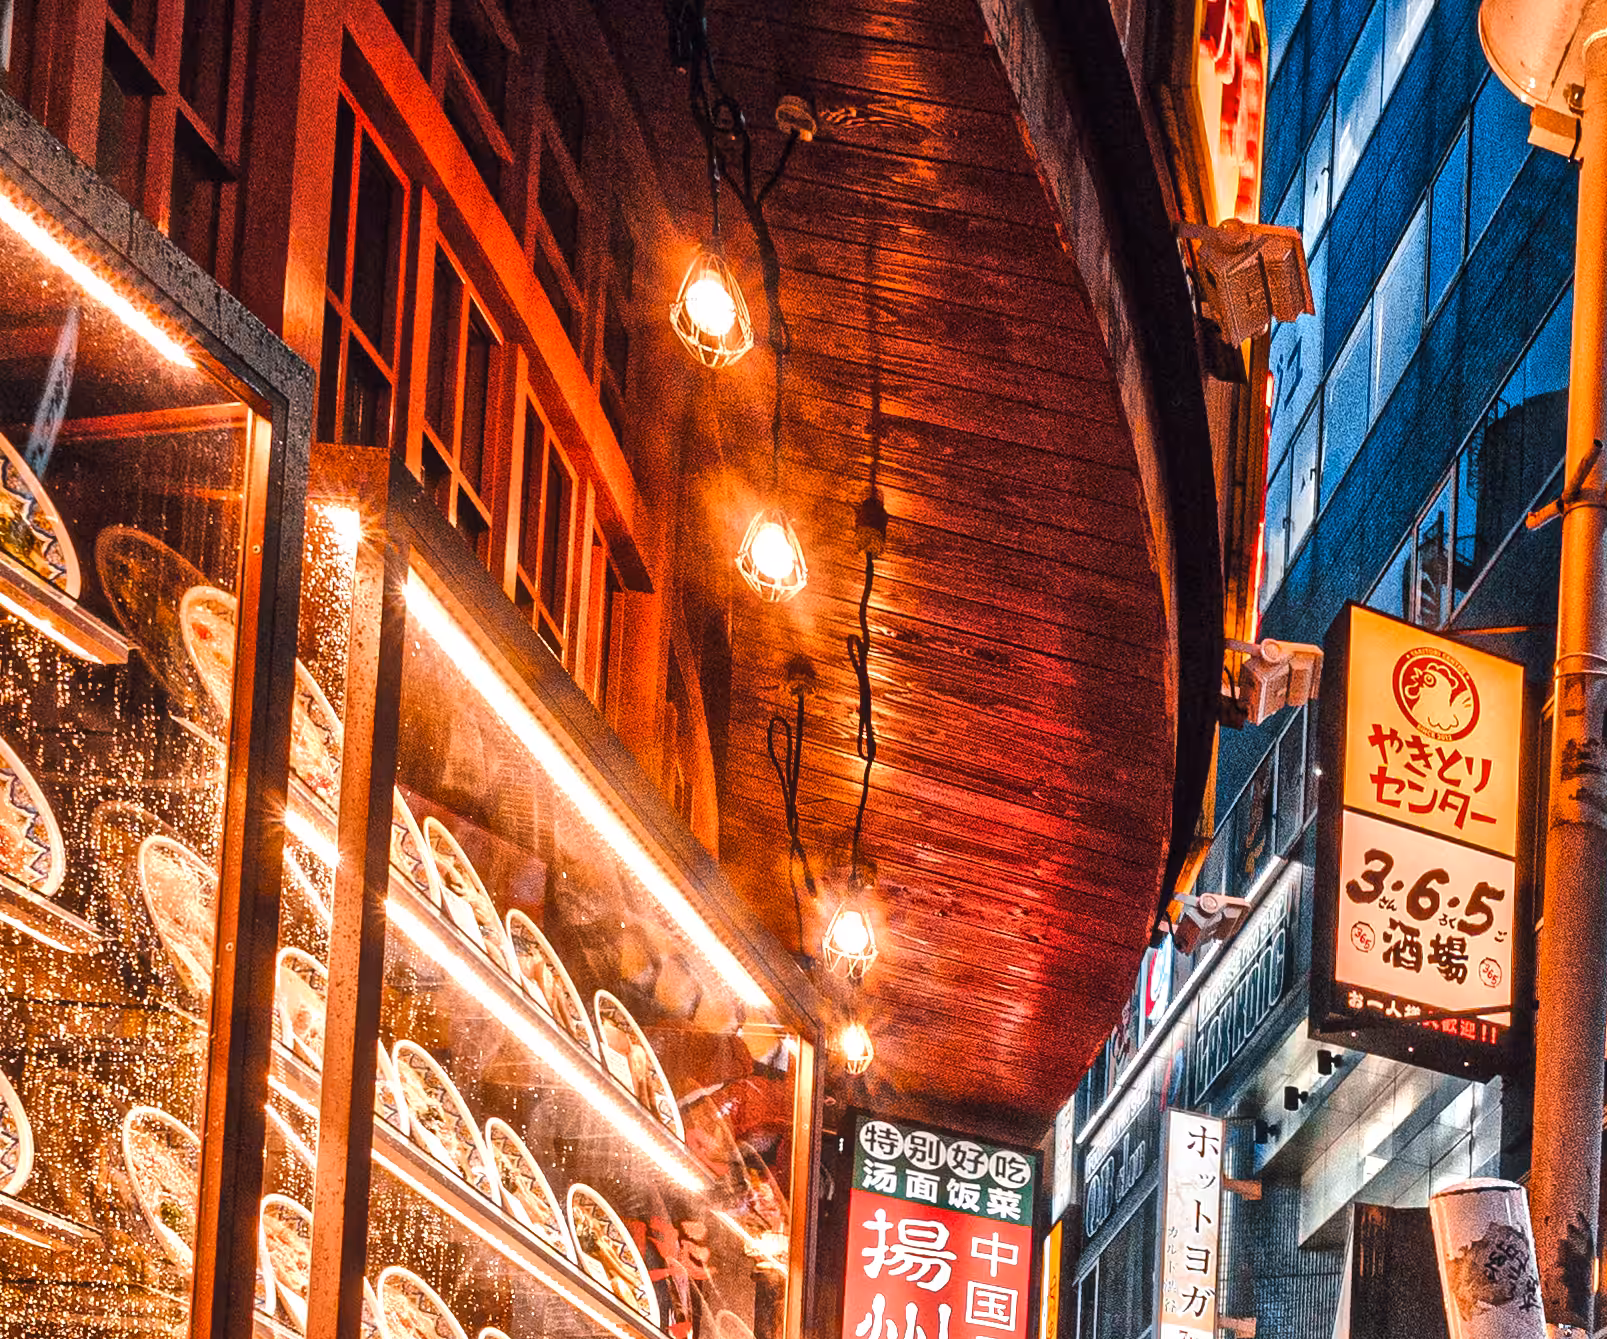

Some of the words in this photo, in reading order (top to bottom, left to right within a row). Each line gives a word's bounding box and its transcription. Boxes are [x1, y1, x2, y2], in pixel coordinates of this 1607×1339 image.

[1368, 723, 1493, 793] やきとり
[1370, 767, 1497, 830] センター
[1382, 917, 1468, 985] 酒場
[1182, 1125, 1220, 1318] ホットヨガ
